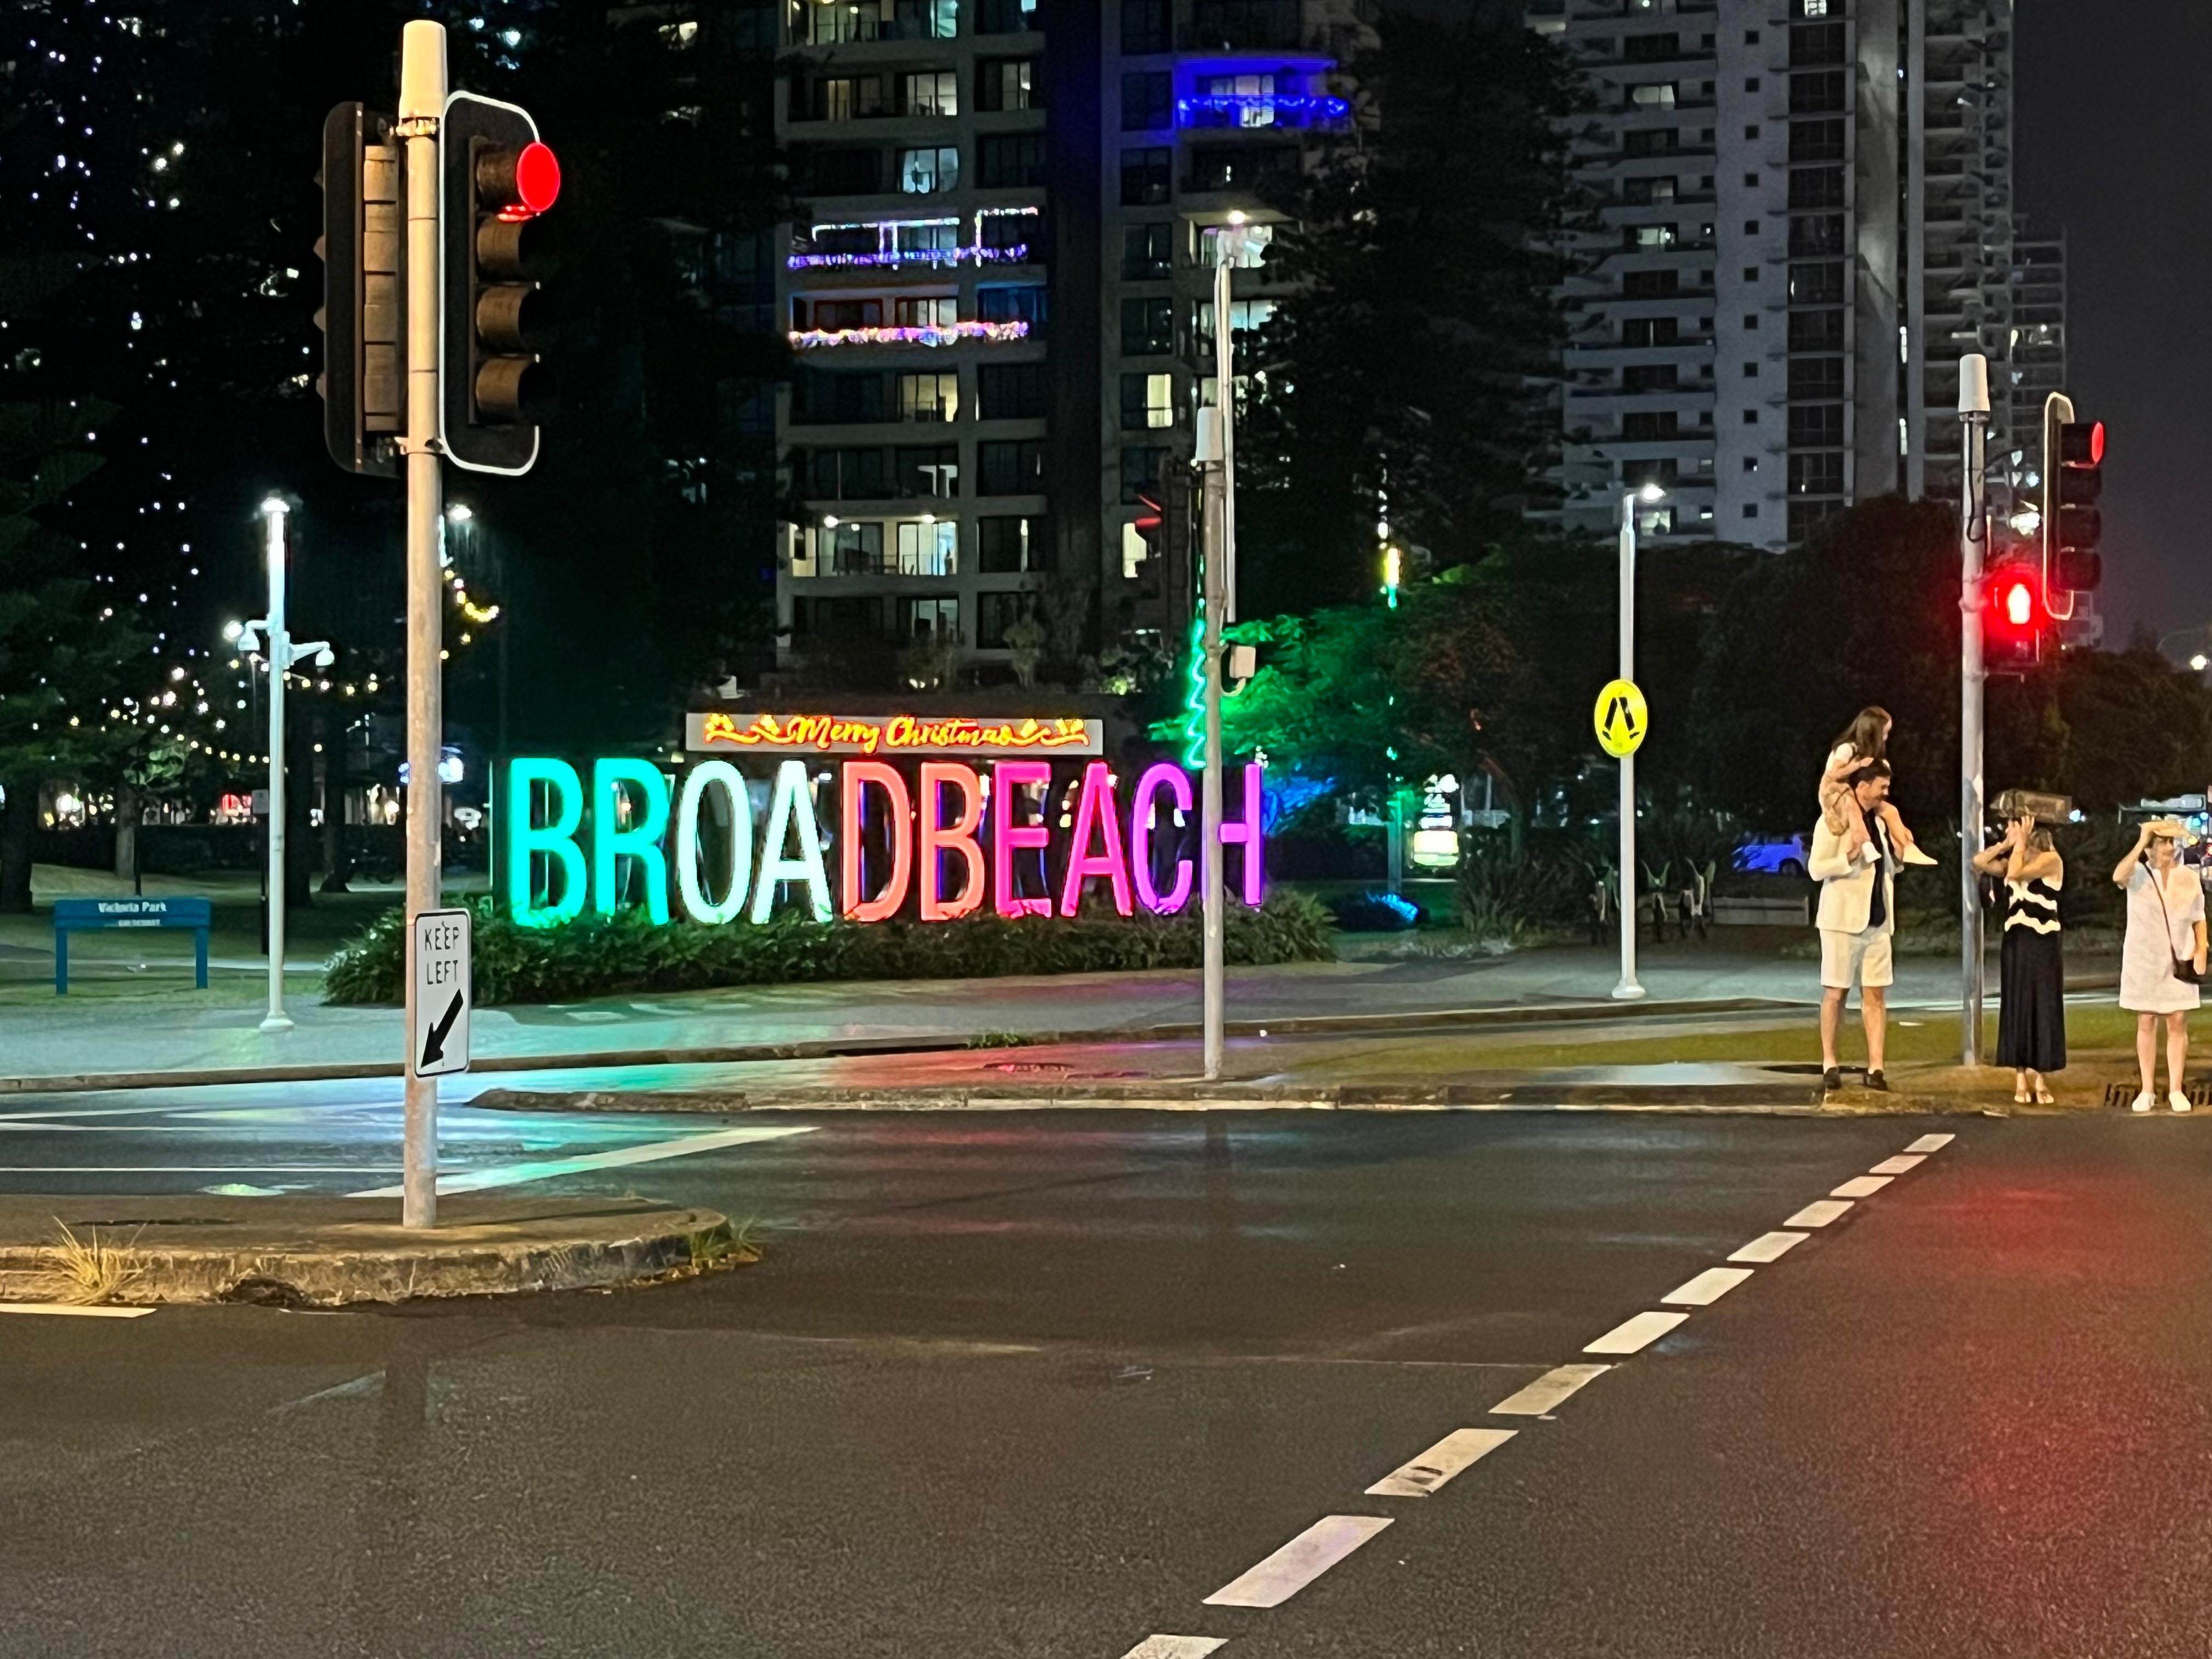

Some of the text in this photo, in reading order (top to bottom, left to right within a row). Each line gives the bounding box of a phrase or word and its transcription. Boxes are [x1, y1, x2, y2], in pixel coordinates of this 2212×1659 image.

[787, 715, 1014, 754] Merry Christmas
[508, 757, 1264, 927] BROADBEACH
[142, 901, 166, 912] Park
[425, 926, 459, 951] KEEP
[427, 960, 458, 985] LEFT
